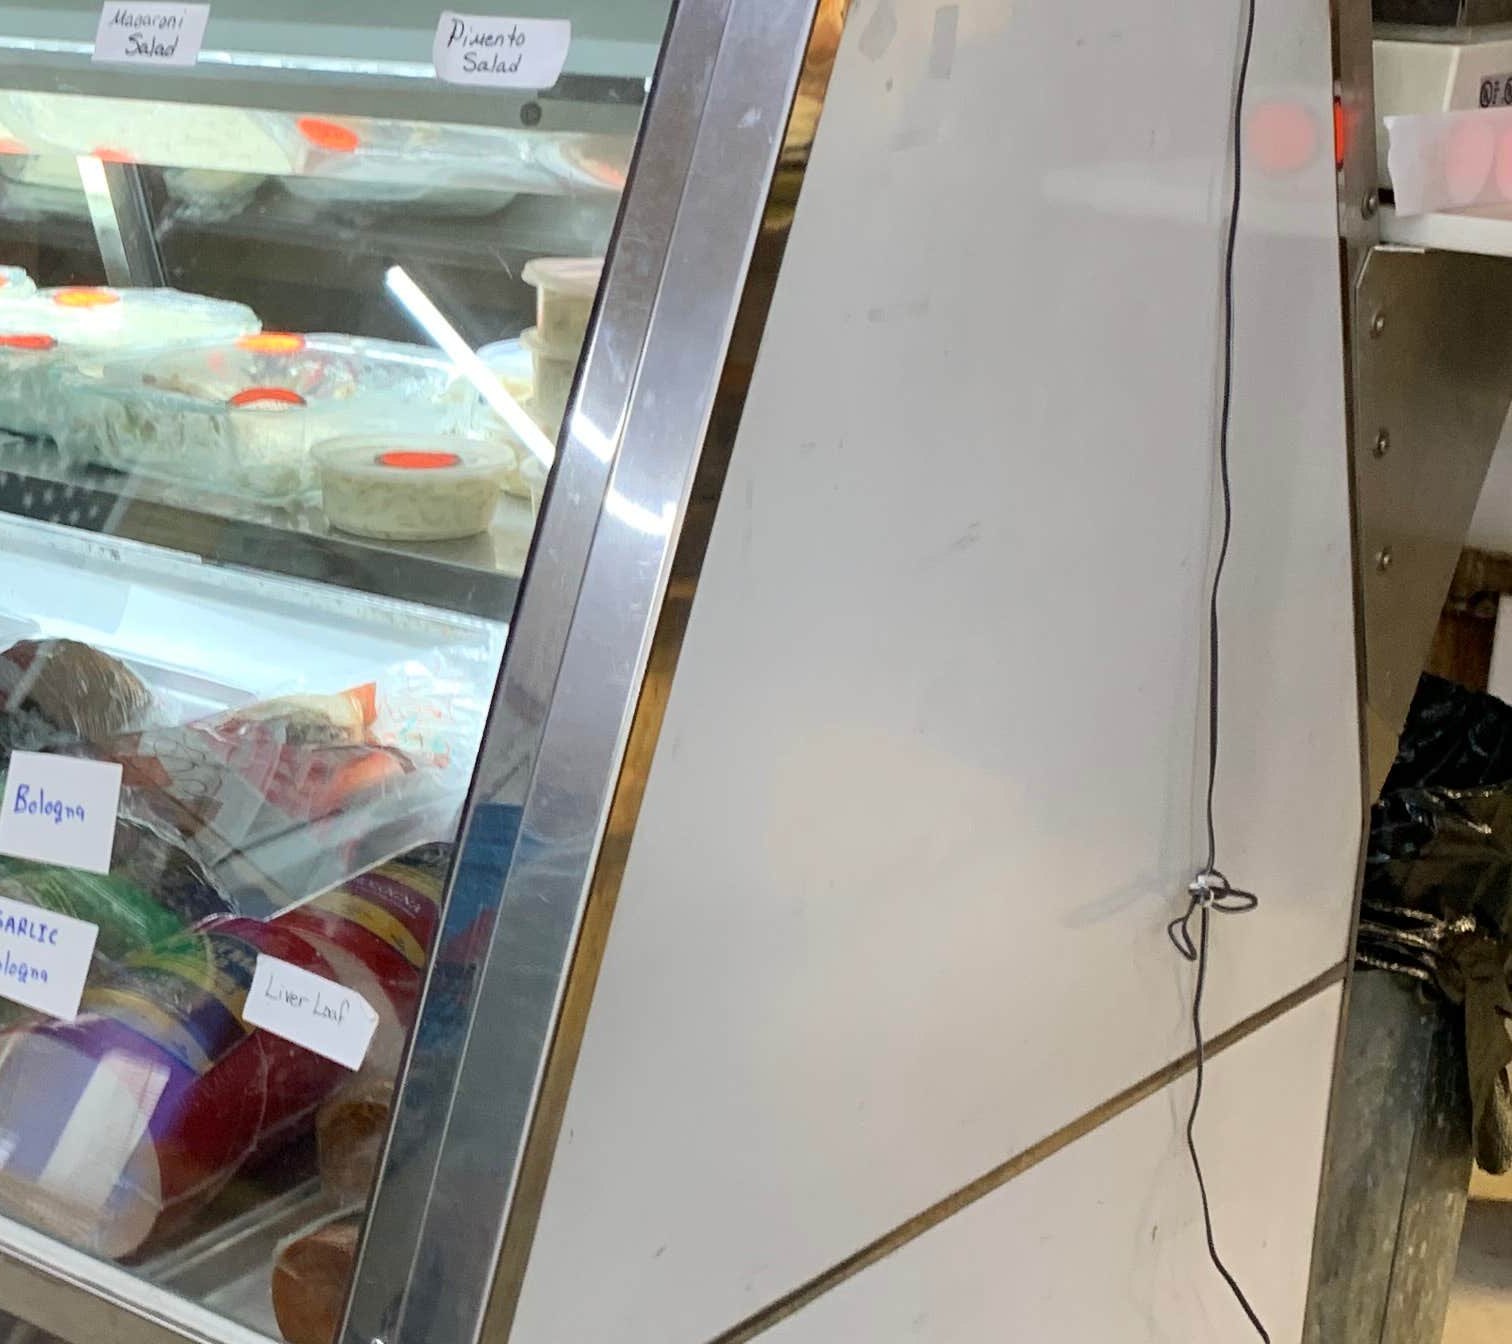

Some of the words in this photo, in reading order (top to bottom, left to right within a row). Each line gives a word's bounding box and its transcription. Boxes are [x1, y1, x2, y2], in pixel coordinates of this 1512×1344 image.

[124, 32, 180, 59] Salad
[447, 17, 526, 49] Pimento
[462, 51, 523, 74] Salad
[12, 783, 86, 824] Bologna
[264, 975, 308, 1009] Liver
[312, 999, 352, 1024] Loaf
